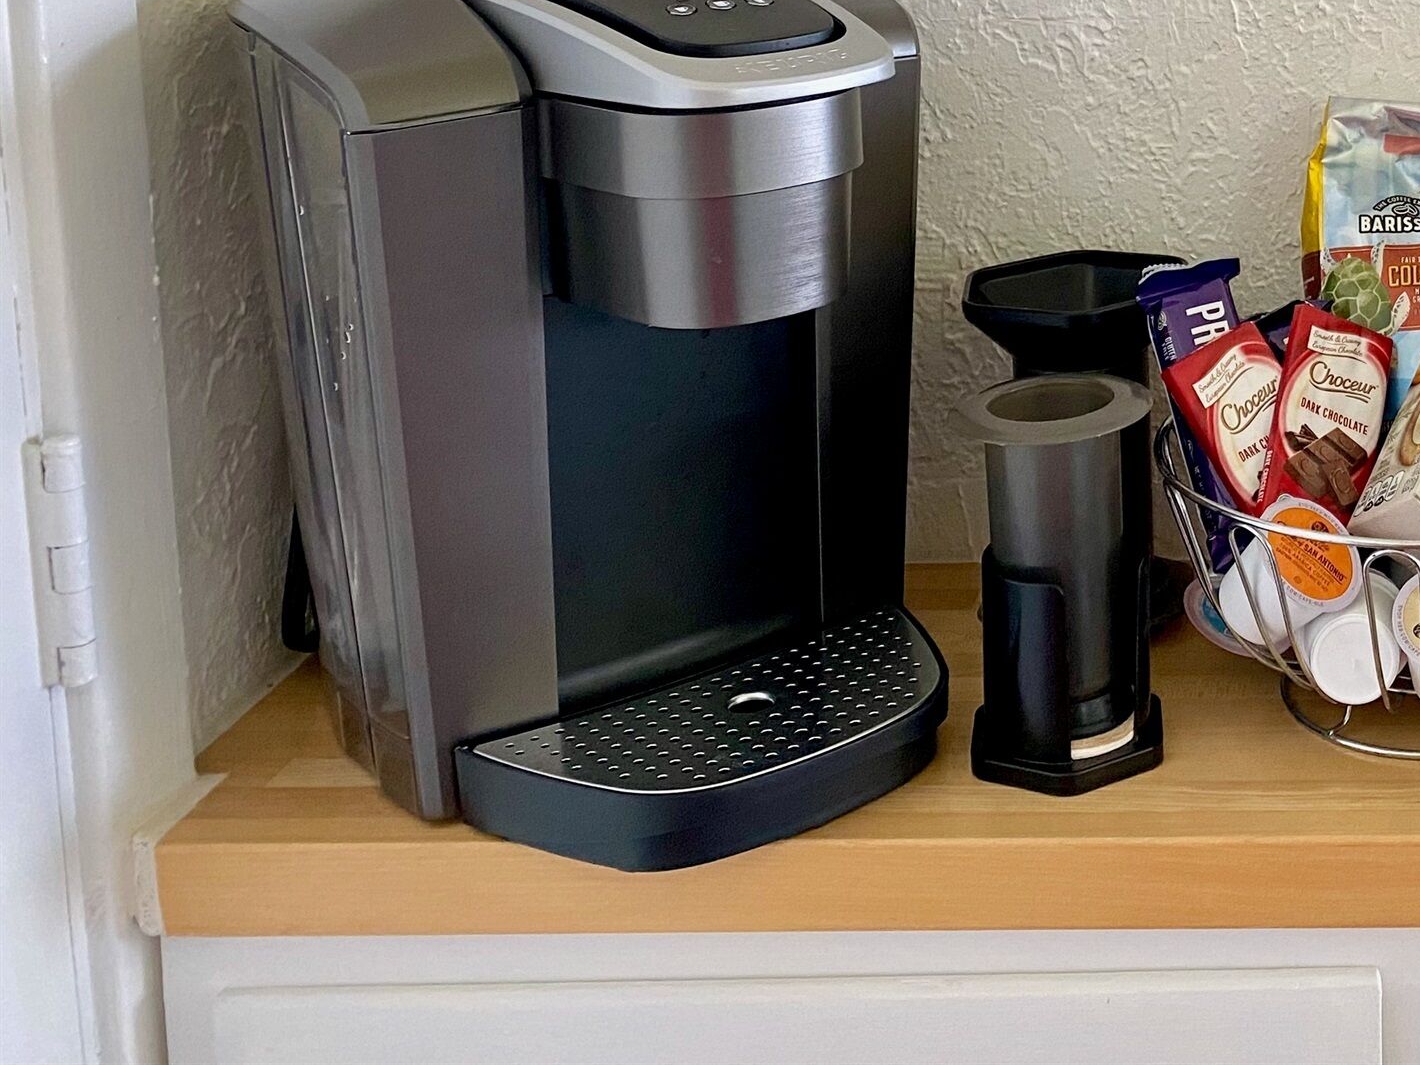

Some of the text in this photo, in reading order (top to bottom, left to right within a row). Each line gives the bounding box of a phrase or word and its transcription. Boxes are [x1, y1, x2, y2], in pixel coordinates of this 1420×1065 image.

[1375, 200, 1388, 211] THE
[1387, 195, 1412, 204] COFFEE
[1164, 336, 1178, 362] GLUTEN
[1338, 346, 1363, 357] Chocolate
[1309, 361, 1376, 395] Choceur
[1221, 378, 1277, 431] Choceur
[1301, 397, 1369, 436] DARK CHOCOLATE
[1238, 442, 1260, 462] DARK
[1257, 450, 1273, 503] DARK CHOCOLATE
[1303, 543, 1318, 559] SAN
[1318, 555, 1344, 582] ANTONIO
